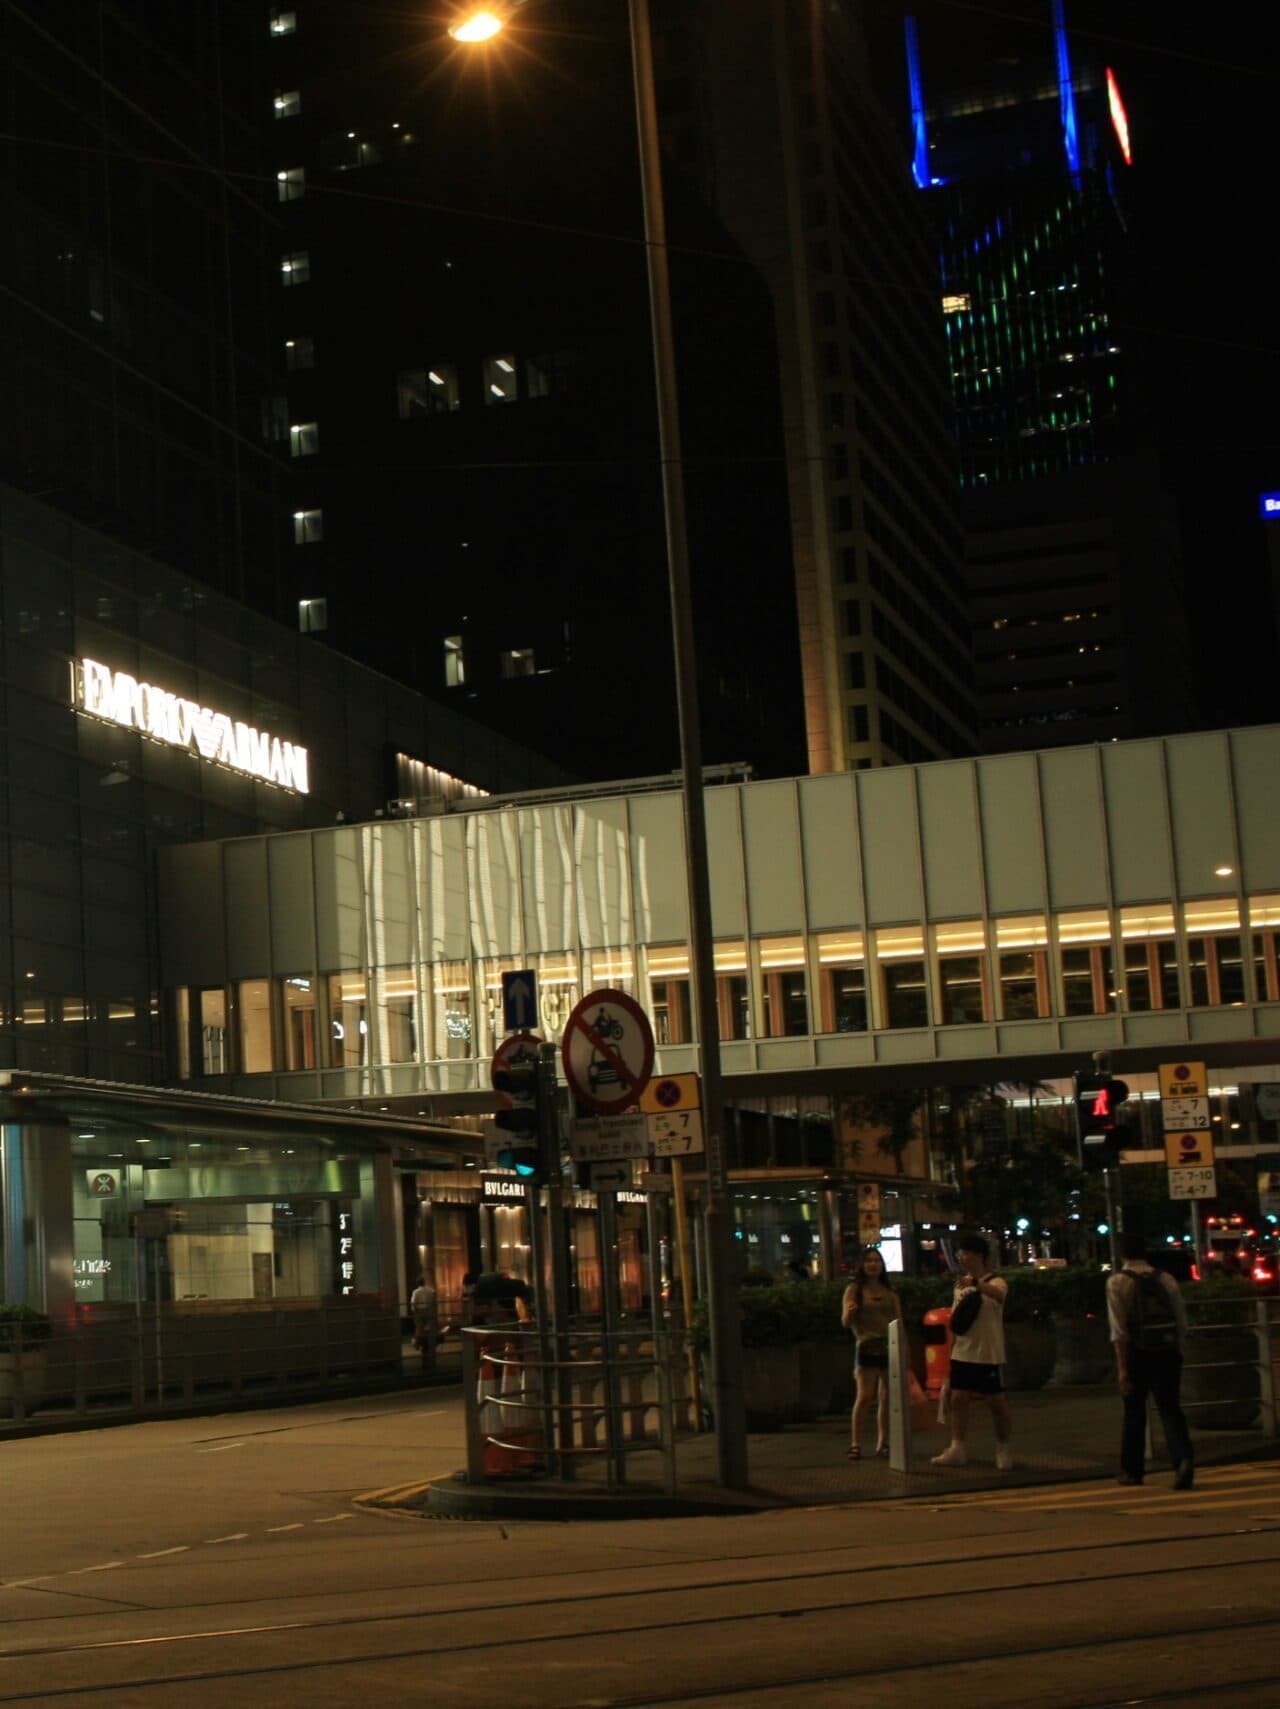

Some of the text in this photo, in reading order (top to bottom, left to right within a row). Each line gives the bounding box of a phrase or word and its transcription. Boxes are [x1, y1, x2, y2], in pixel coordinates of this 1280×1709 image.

[679, 1113, 690, 1128] 7
[682, 1135, 692, 1151] 7
[484, 1180, 526, 1197] BVLGARI
